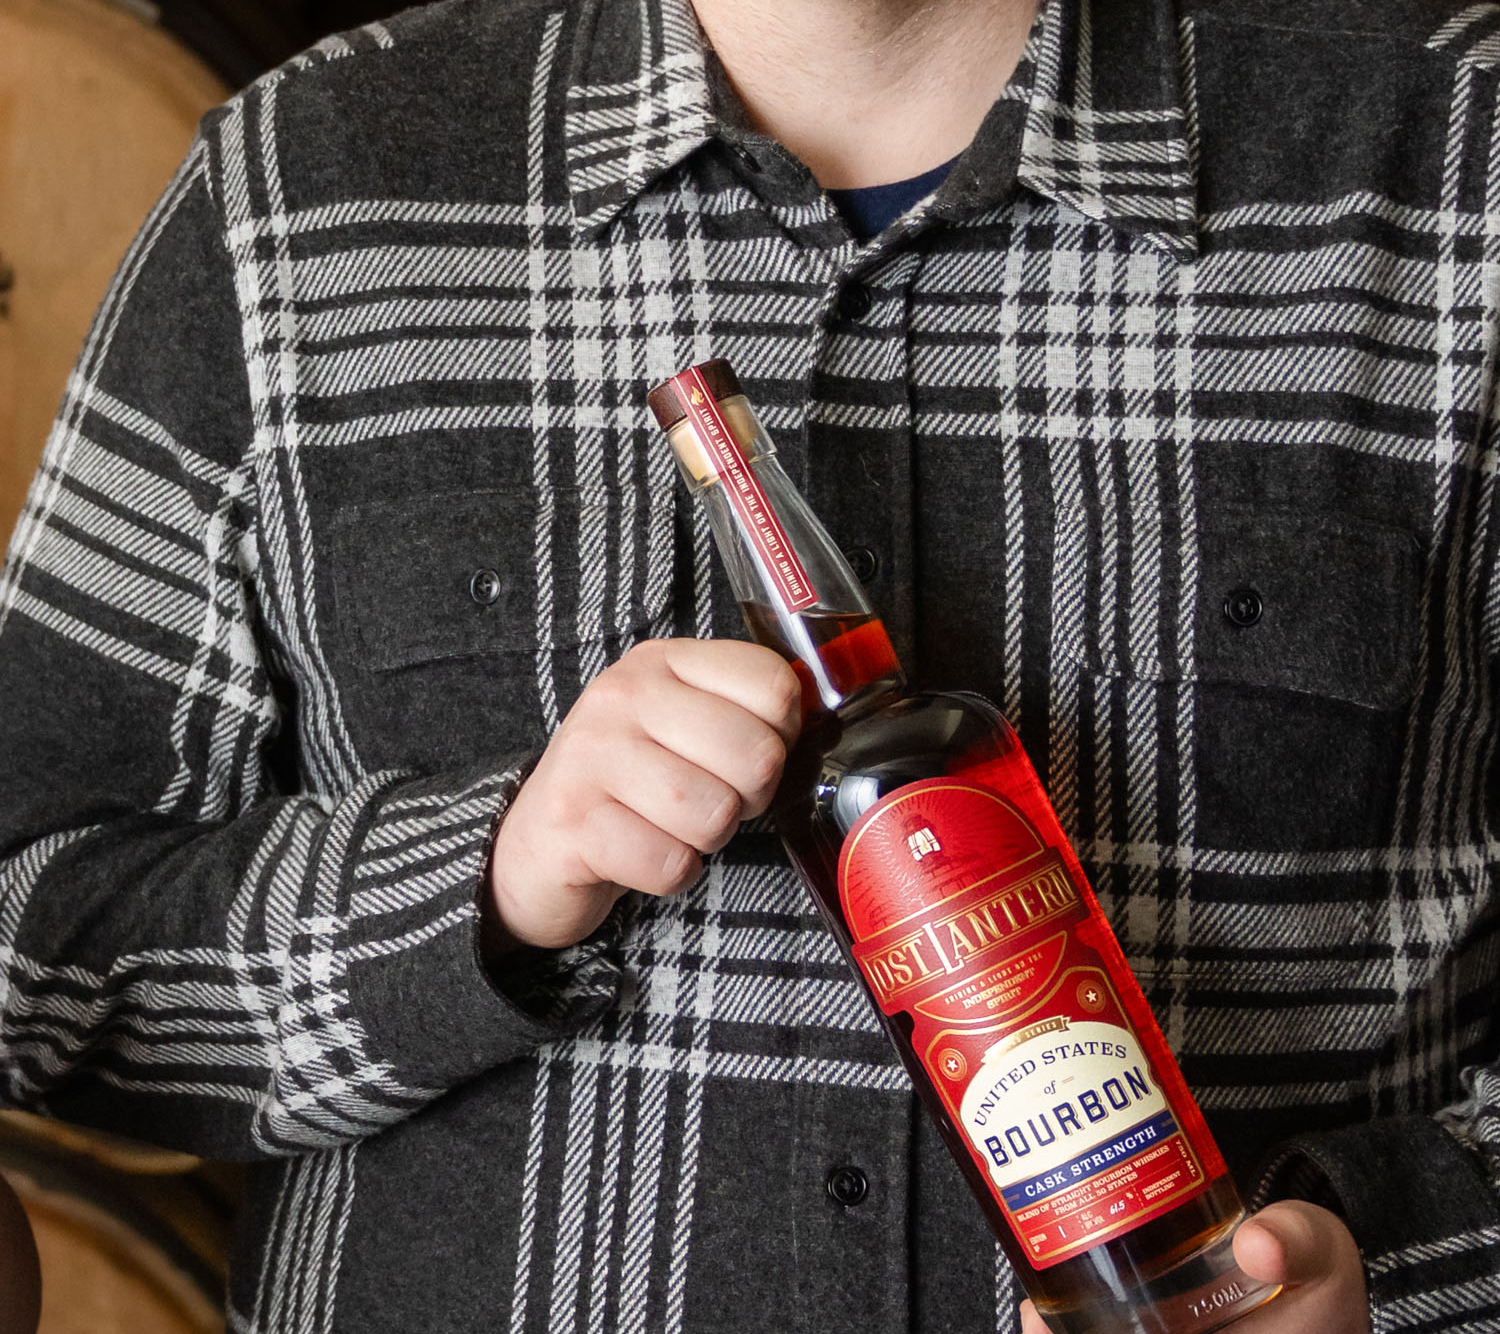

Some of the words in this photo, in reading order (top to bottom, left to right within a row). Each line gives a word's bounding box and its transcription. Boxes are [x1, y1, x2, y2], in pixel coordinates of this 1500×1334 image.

[698, 407, 721, 437] SPIRIT
[715, 437, 751, 494] INDEPENDENT
[743, 492, 760, 512] THE
[752, 508, 766, 524] ON
[759, 524, 781, 552] LIGHT
[774, 550, 784, 559] A
[778, 560, 803, 597] SHINING
[921, 865, 1078, 976] LANTERN
[961, 966, 1037, 1010] INDEPENDENT
[985, 986, 1023, 1011] SPIRIT
[1025, 1020, 1059, 1040] SERIES
[973, 1059, 1038, 1127] UNITED
[1041, 1041, 1128, 1066] STATES
[1043, 1080, 1056, 1096] of
[983, 1065, 1153, 1168] BOURBON
[1024, 1170, 1069, 1198] CASK
[1069, 1125, 1158, 1178] STRENGTH
[1016, 1208, 1041, 1223] BLEND
[1040, 1203, 1051, 1214] OF
[1050, 1182, 1093, 1210] STRAIGHT
[1092, 1164, 1134, 1188] BOURBON
[1132, 1145, 1171, 1170] WHISKIES
[1053, 1201, 1079, 1217] FROM
[1078, 1195, 1096, 1207] ALL
[1095, 1187, 1108, 1198] 50
[1106, 1171, 1139, 1192] STATES
[1109, 1200, 1126, 1216] 61.5
[1142, 1170, 1182, 1195] INDEPENDENT
[1145, 1181, 1176, 1201] BOTTLING
